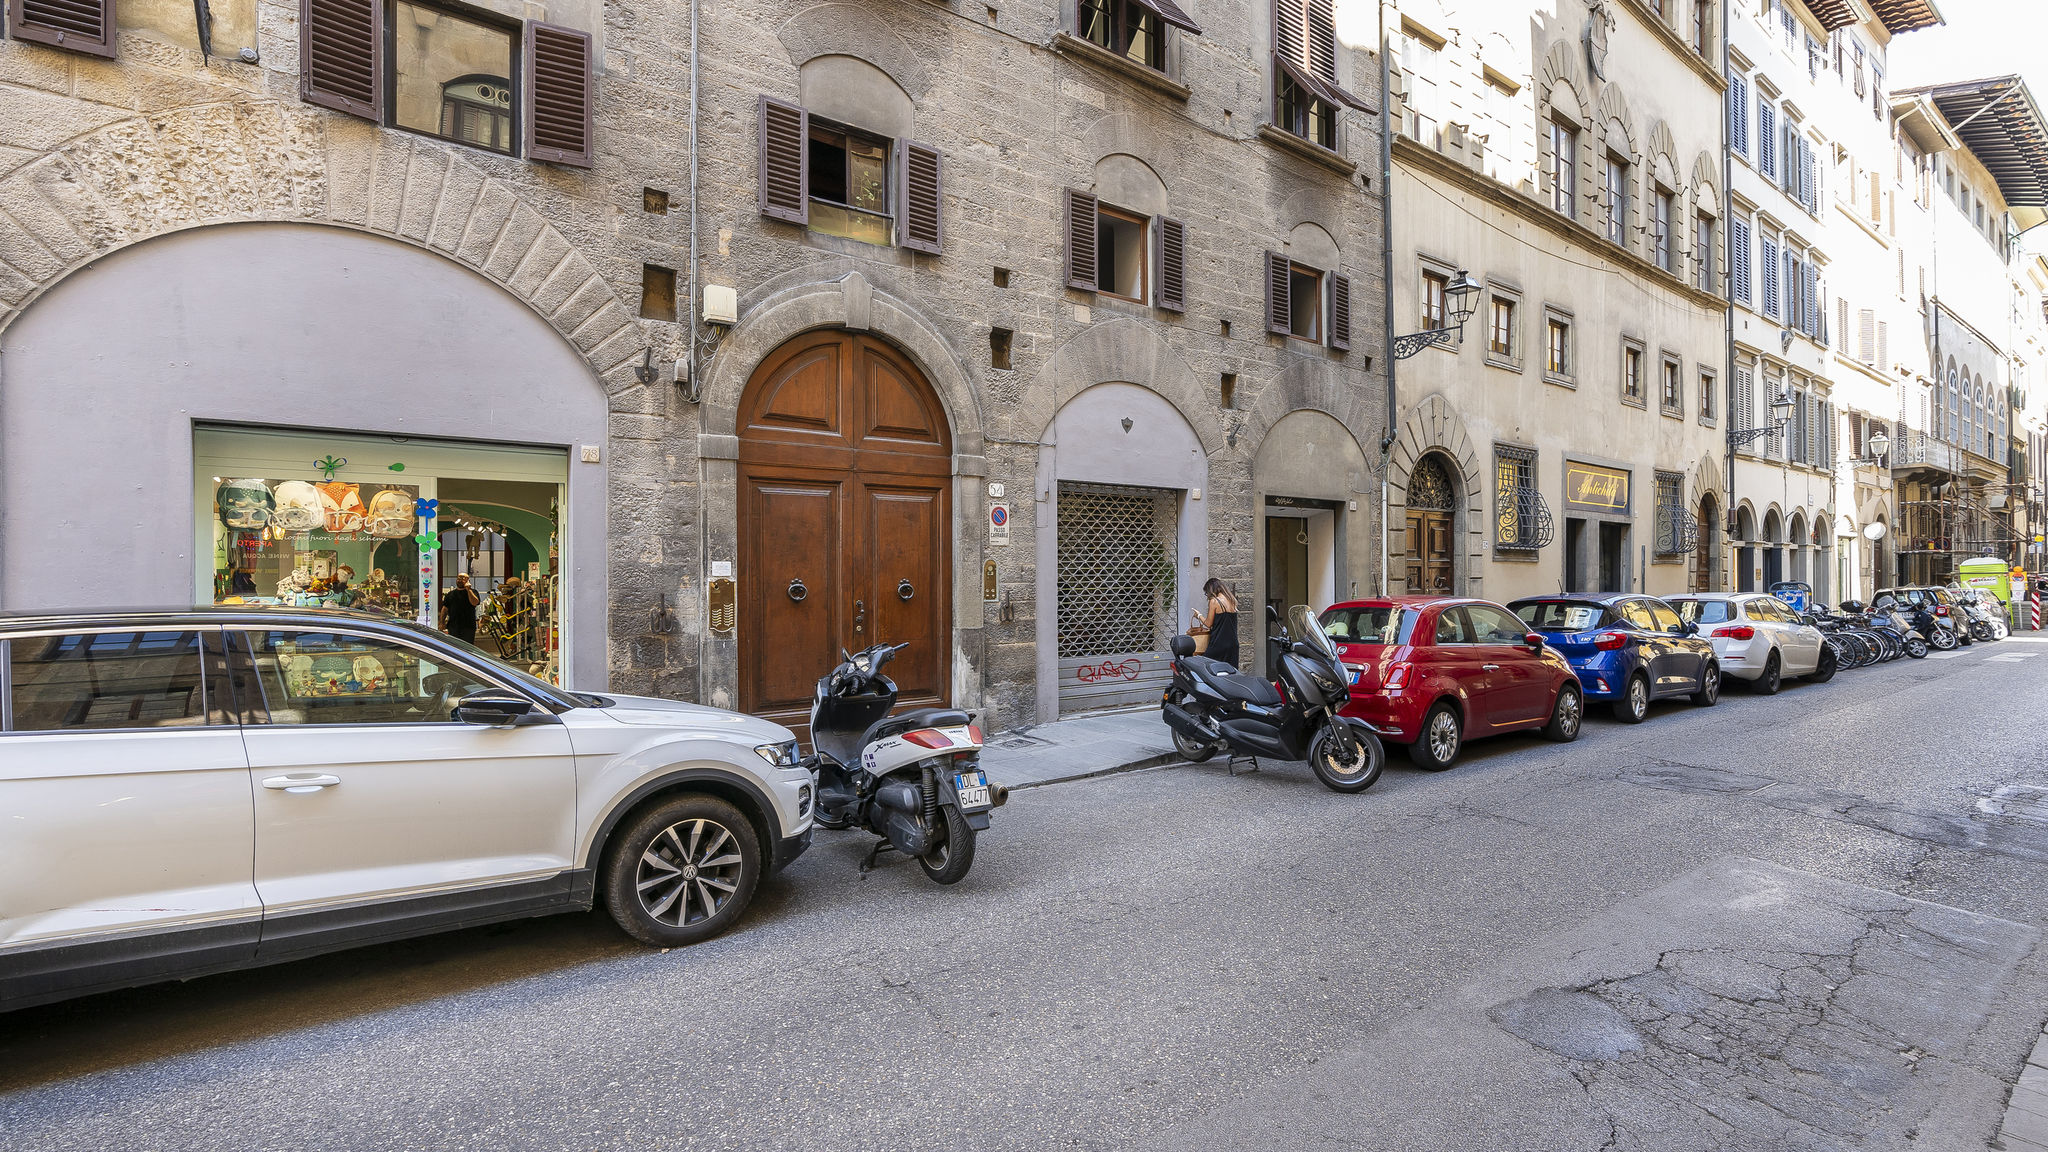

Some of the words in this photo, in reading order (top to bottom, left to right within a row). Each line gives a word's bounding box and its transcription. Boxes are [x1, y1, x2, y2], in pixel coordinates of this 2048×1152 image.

[583, 448, 598, 459] 78
[990, 484, 1003, 496] 54
[335, 533, 357, 542] dagli
[359, 533, 389, 541] schemi
[963, 775, 975, 787] DL
[961, 789, 987, 805] 64477
